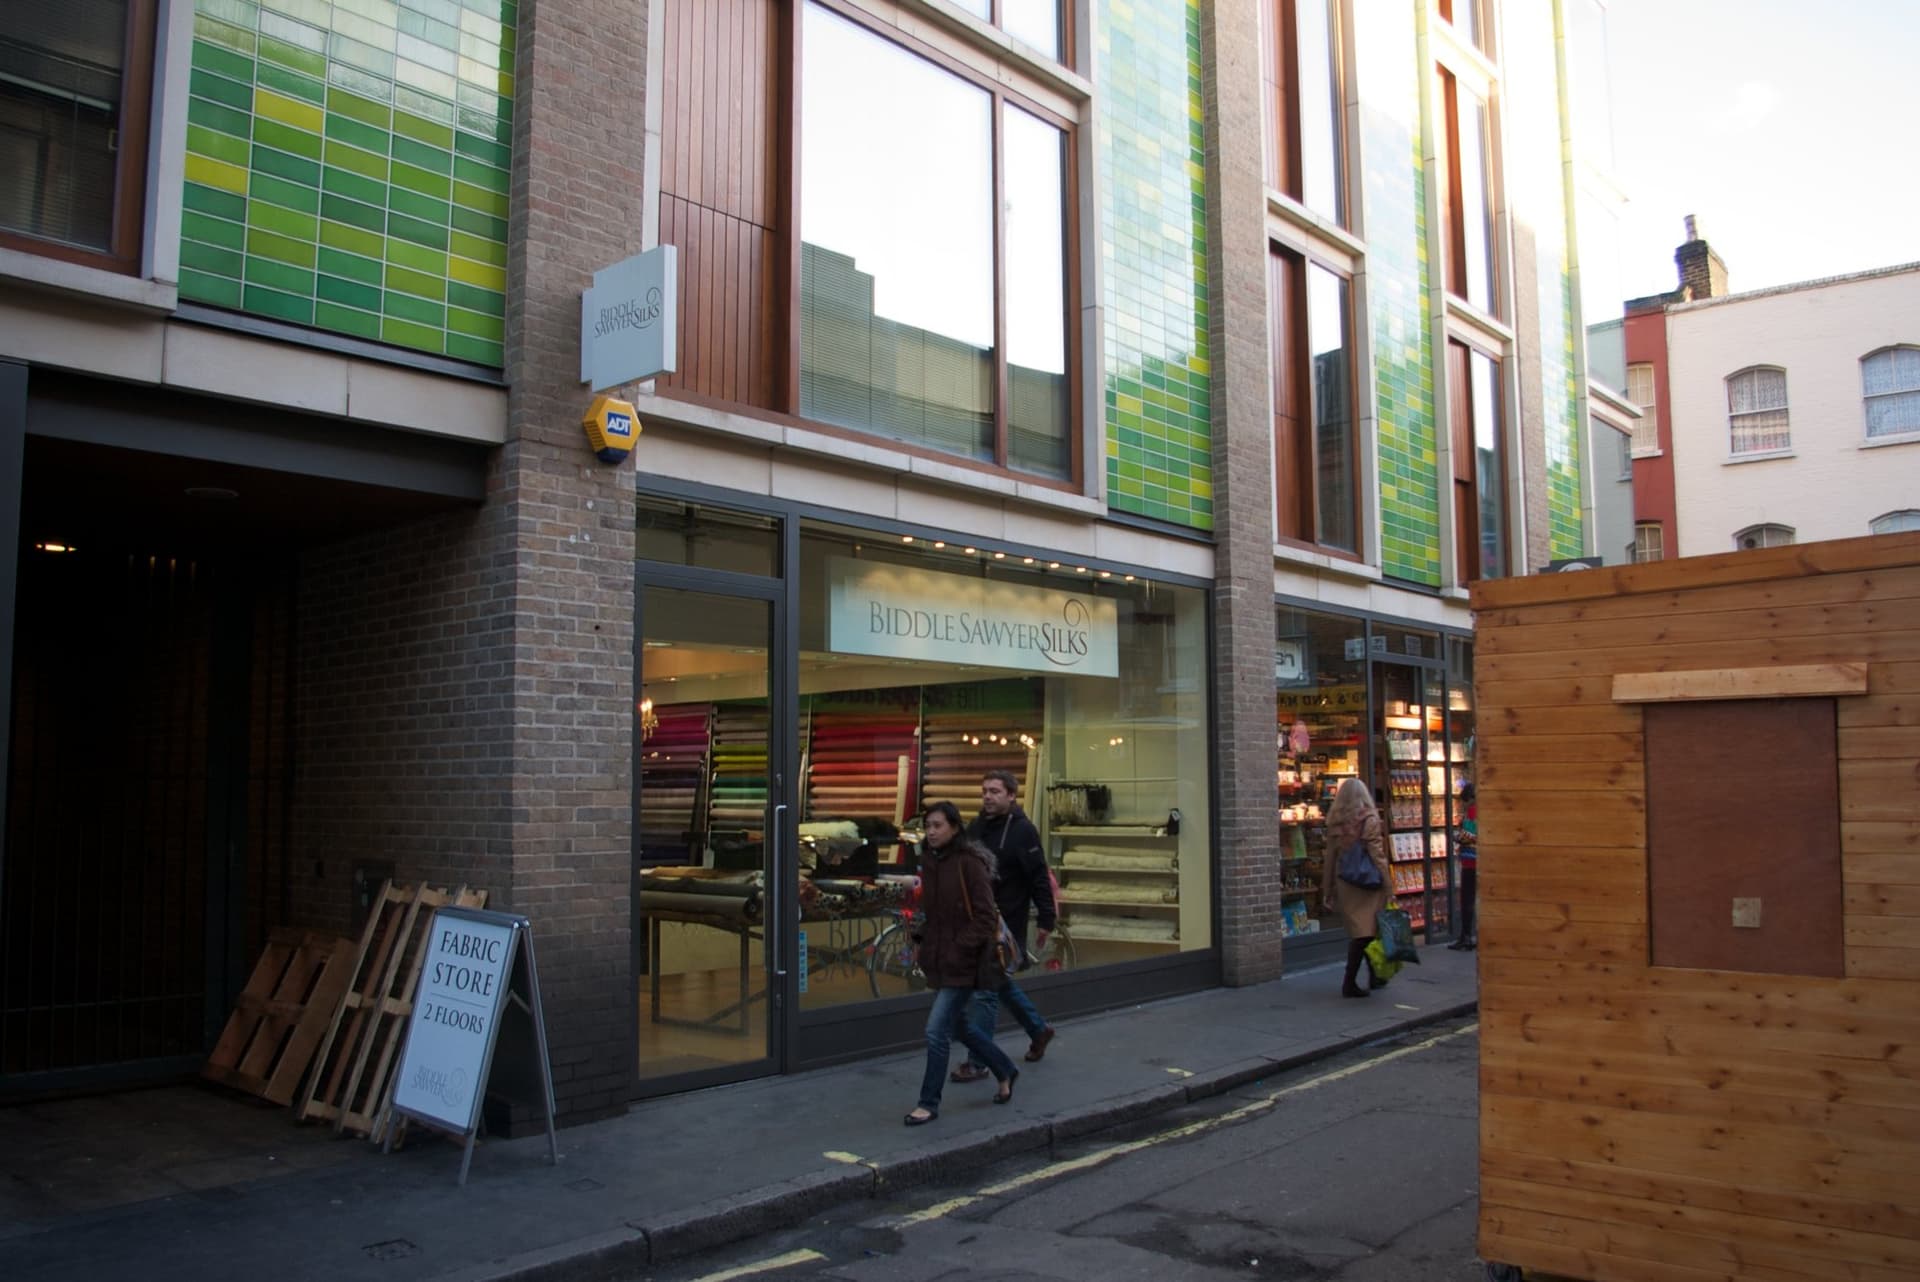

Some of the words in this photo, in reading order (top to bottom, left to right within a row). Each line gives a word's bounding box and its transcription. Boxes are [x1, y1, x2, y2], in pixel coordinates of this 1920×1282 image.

[607, 416, 631, 434] ADT
[869, 600, 955, 642] BIDDLE
[440, 931, 501, 964] FABRIC
[433, 962, 494, 997] STORE
[424, 1003, 433, 1020] 2
[434, 1008, 485, 1034] FLOORS
